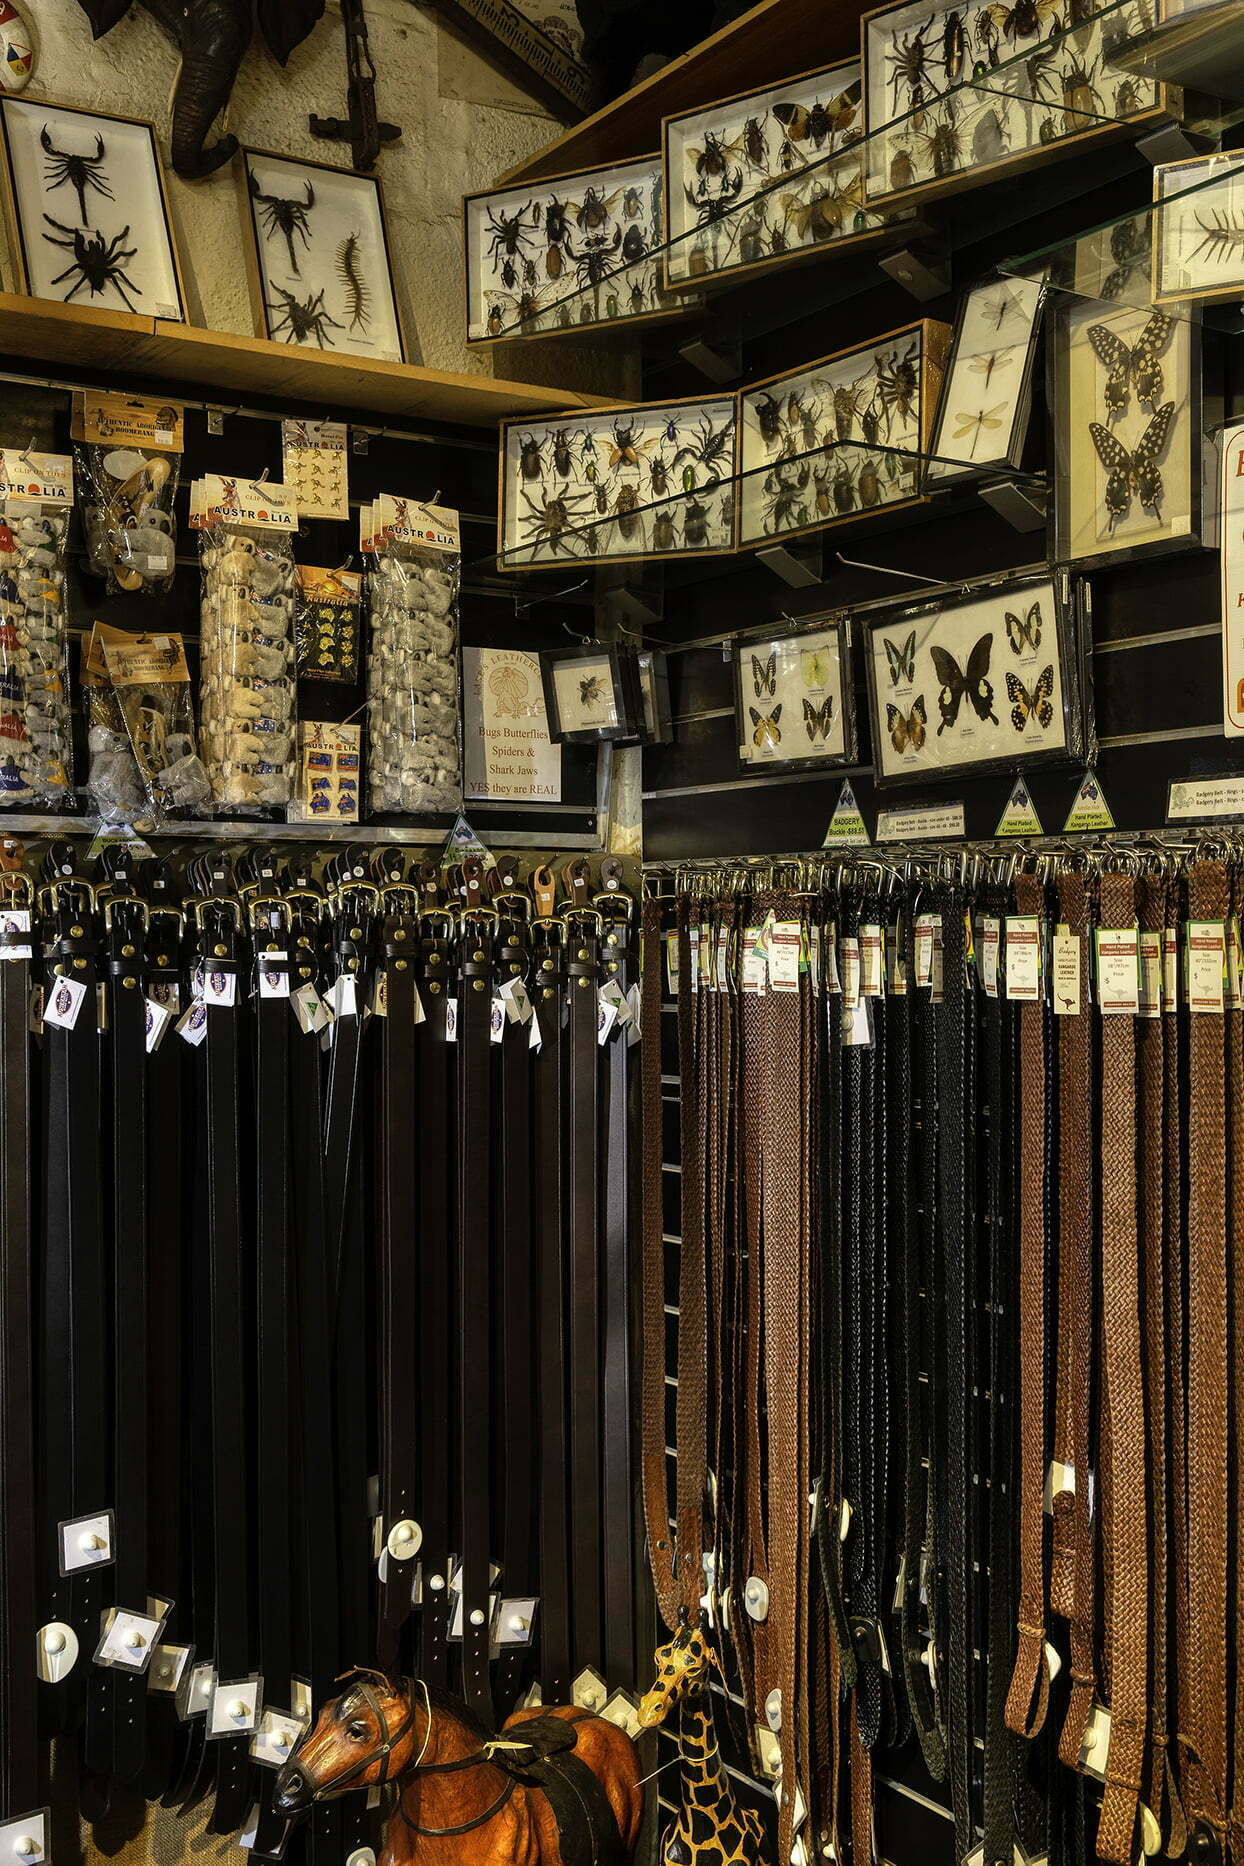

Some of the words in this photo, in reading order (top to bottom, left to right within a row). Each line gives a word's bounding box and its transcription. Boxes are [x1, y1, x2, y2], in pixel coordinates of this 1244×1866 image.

[479, 726, 502, 740] Bugs
[503, 728, 549, 740] Butterflies
[492, 745, 525, 758] Spiders
[526, 747, 536, 758] &
[489, 763, 515, 775] Shark
[517, 765, 539, 776] Jaws
[470, 782, 490, 793] YES
[492, 782, 512, 796] they
[513, 785, 529, 794] are
[529, 784, 558, 795] REAL
